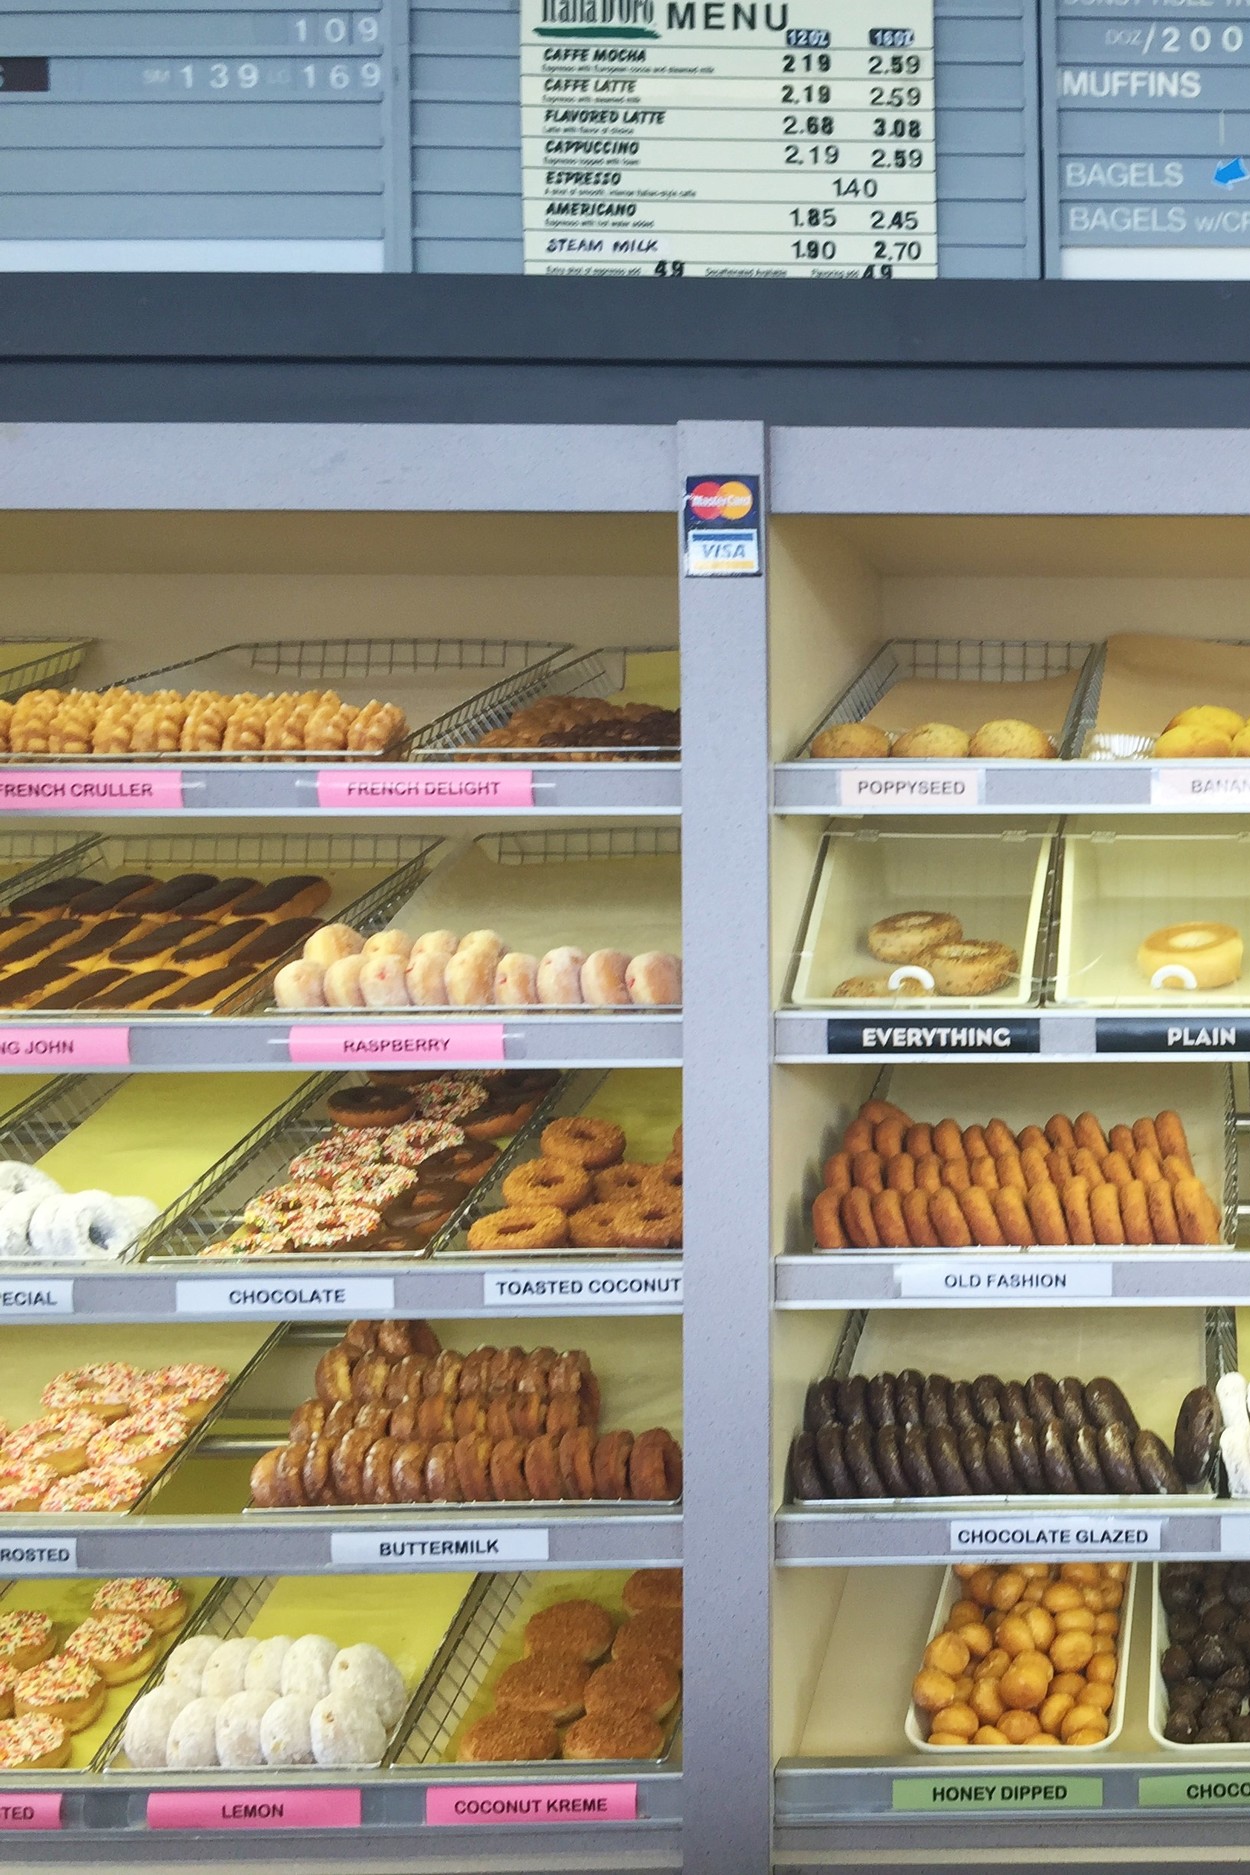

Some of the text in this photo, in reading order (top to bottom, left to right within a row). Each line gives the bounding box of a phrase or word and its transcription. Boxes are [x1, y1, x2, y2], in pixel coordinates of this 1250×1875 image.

[667, 2, 788, 31] MENU
[543, 49, 590, 62] CAFFE
[592, 49, 647, 63] MOCHA
[868, 55, 920, 75] 2.59
[1062, 70, 1202, 98] MUFFINS
[544, 79, 590, 93] CAFFE
[594, 79, 638, 93] LATTE
[870, 86, 922, 107] 2.59
[544, 110, 618, 124] FLAVORED
[622, 111, 666, 124] LATTE
[544, 141, 923, 169] CAPPUCCINO 2.19 2.59
[545, 171, 623, 186] ESPRESSO
[1066, 162, 1185, 188] BAGELS
[545, 203, 638, 217] AMERICANO
[1069, 207, 1187, 232] BAGELS
[547, 238, 659, 253] STEAM MILK
[703, 543, 747, 559] VISA
[71, 782, 153, 798] CRULLER
[347, 781, 500, 797] FRENCH DELIGHT
[857, 780, 966, 796] POPPYSEED
[862, 1027, 1012, 1048] EVERYTHING
[1167, 1027, 1237, 1047] PLAIN
[25, 1040, 74, 1055] JOHN
[343, 1038, 451, 1054] RASPBERRY
[496, 1278, 682, 1295] TOASTED COCONUT
[944, 1273, 1067, 1289] OLD FASHION
[0, 1291, 58, 1306] ECIAL
[229, 1289, 346, 1304] CHOCOLATE
[957, 1528, 1149, 1545] CHOCOLATE GLAZED
[379, 1539, 499, 1557] BUTTERMILK
[932, 1784, 1068, 1802] HONEY DIPPED
[221, 1803, 284, 1819] LEMON
[455, 1798, 608, 1814] COCONUT KREME
